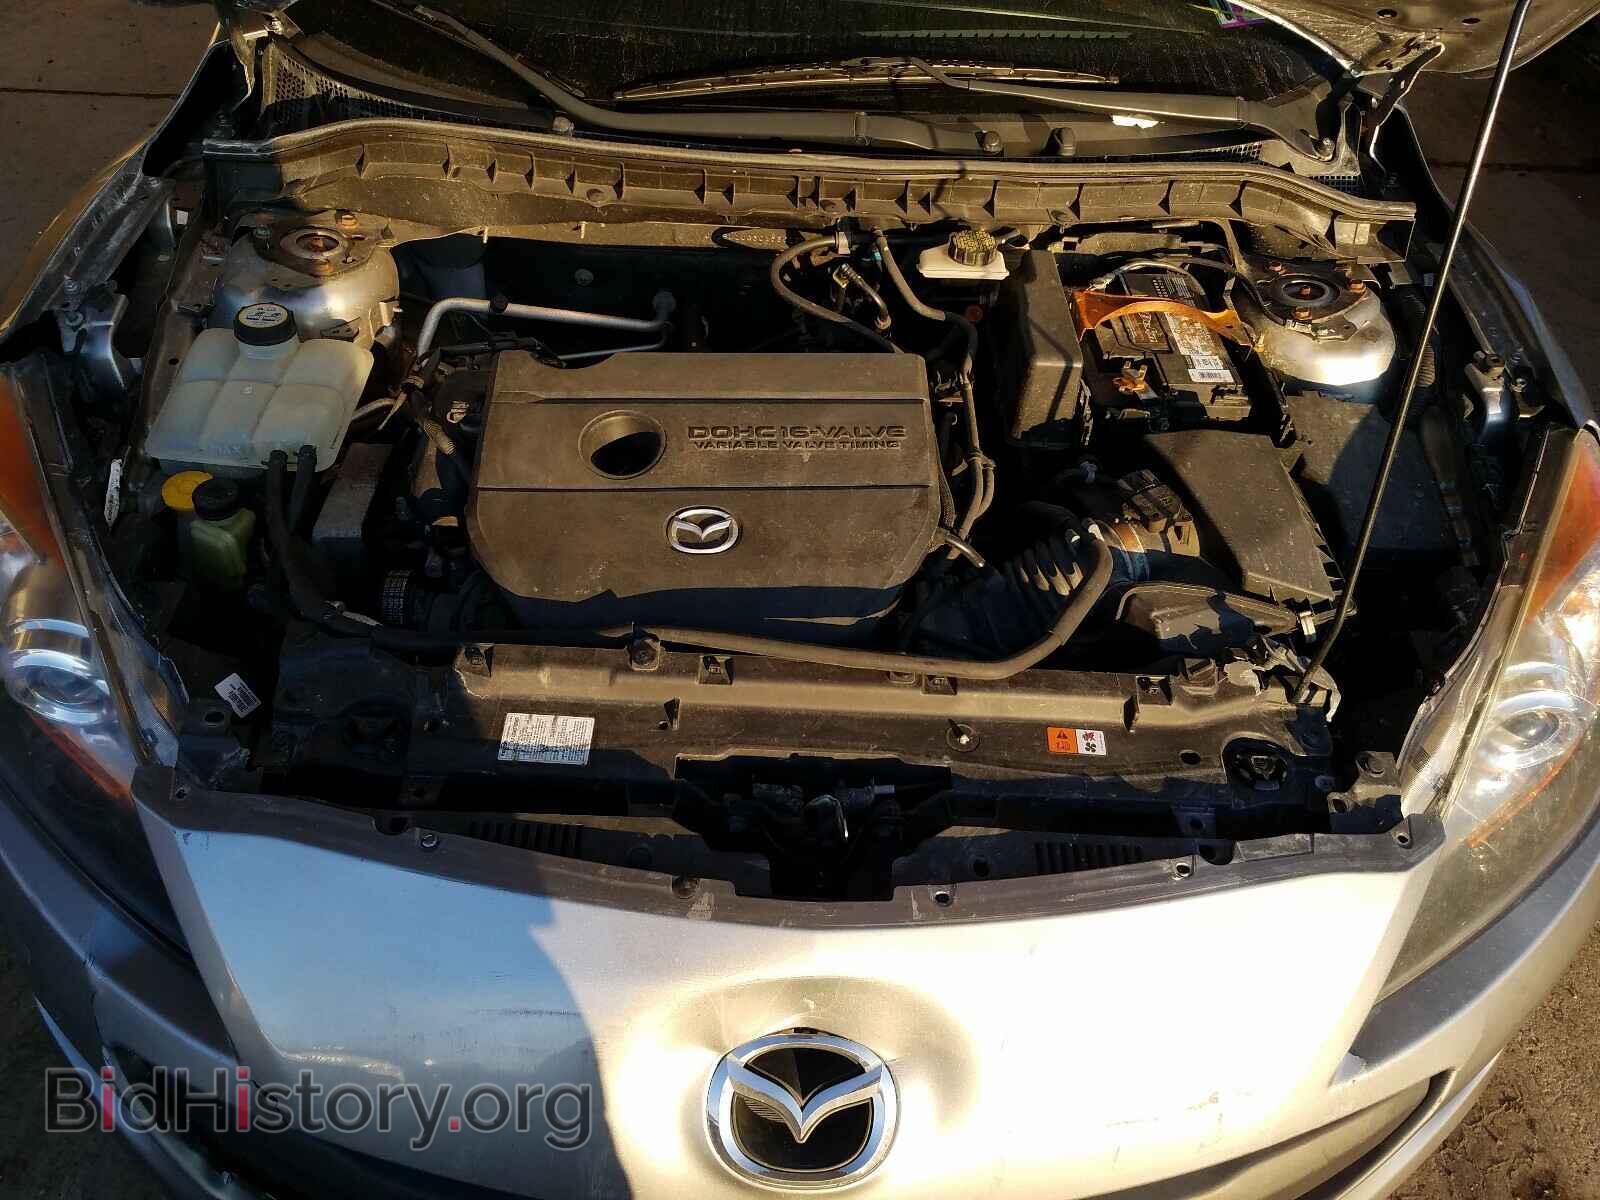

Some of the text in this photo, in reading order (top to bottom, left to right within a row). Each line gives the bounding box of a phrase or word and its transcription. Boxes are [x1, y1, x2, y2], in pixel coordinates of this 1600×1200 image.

[688, 425, 905, 439] DOHC 16-VALVE
[694, 440, 900, 449] VARIABLE VALVE TIMING
